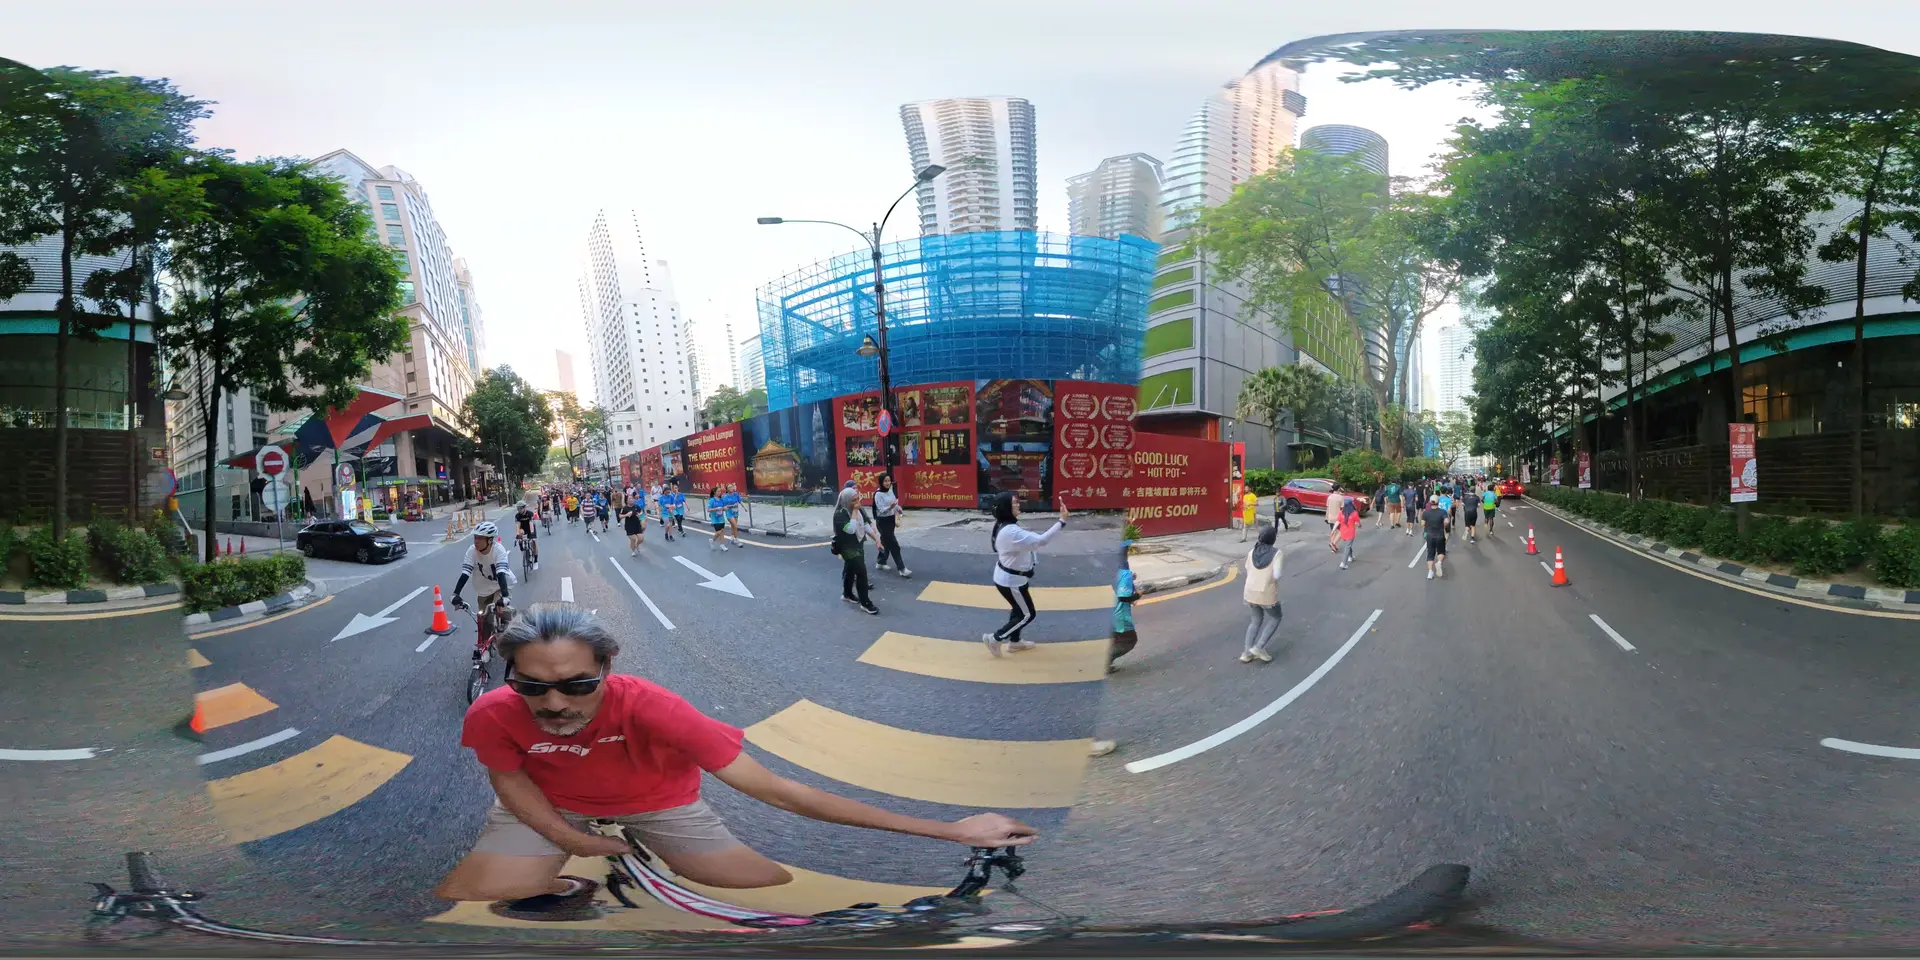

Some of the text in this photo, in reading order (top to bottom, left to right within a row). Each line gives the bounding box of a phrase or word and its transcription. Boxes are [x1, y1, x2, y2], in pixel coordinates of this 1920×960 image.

[715, 430, 734, 440] Lumpur
[688, 446, 737, 462] THE HERITAGE OF
[1134, 451, 1189, 466] GOOD LUCK
[1147, 467, 1180, 478] HOT POT
[904, 492, 973, 502] Flourishing Fortunes
[1127, 504, 1199, 520] NING SOON
